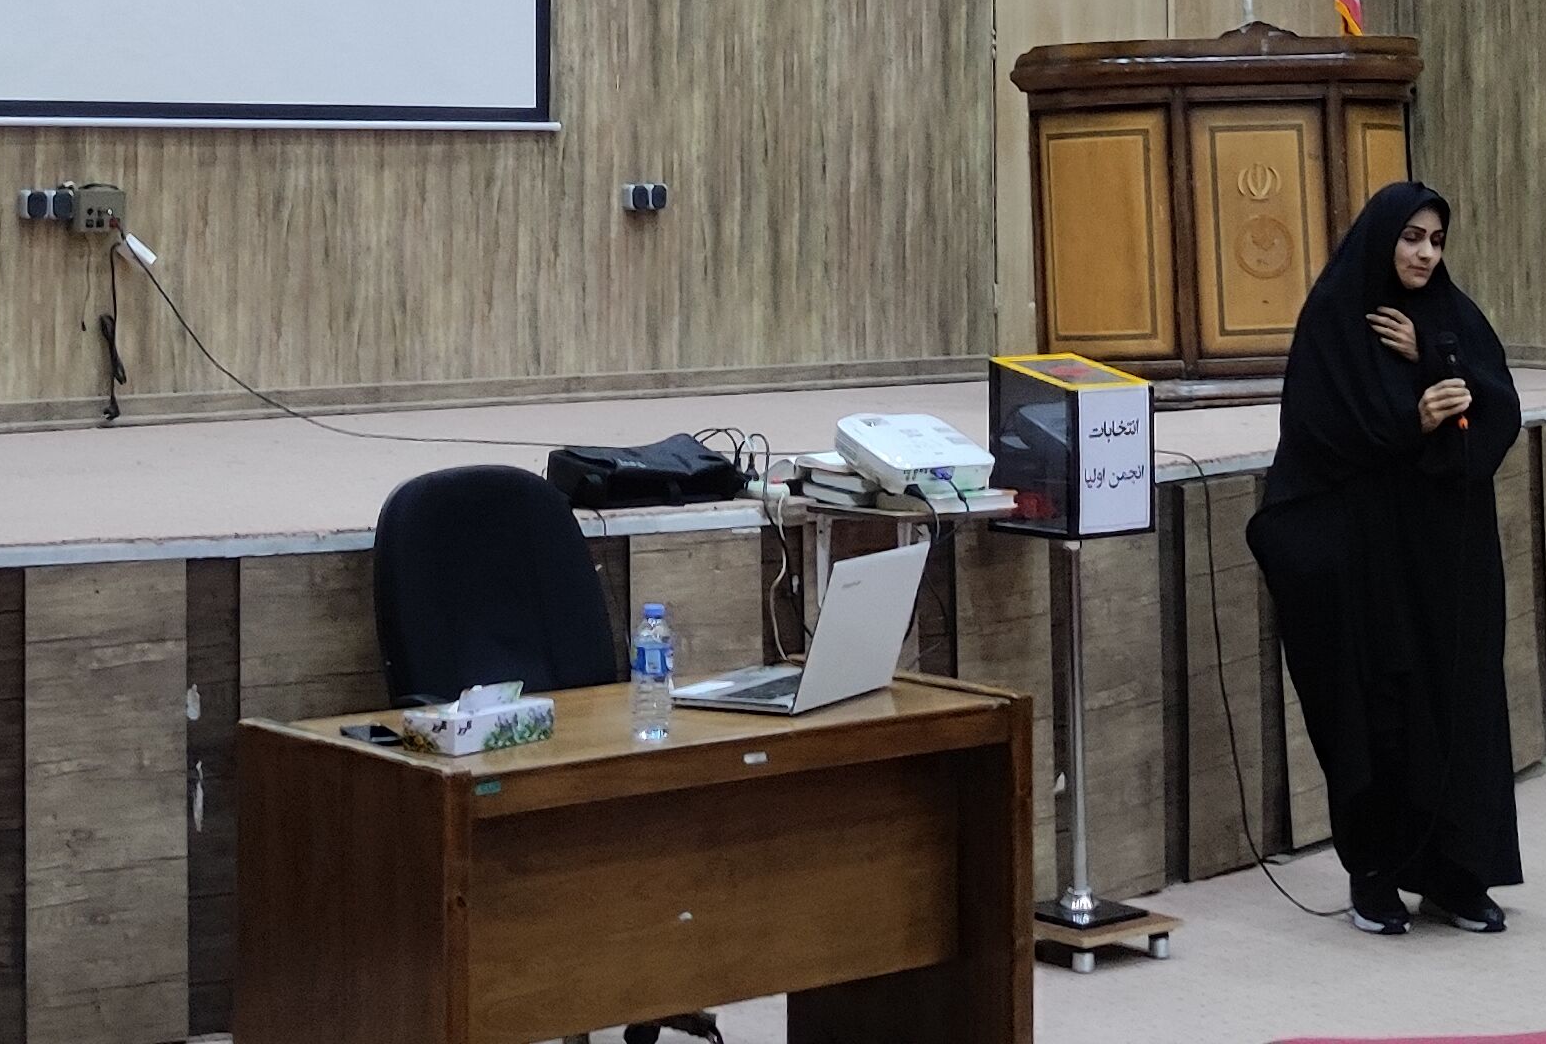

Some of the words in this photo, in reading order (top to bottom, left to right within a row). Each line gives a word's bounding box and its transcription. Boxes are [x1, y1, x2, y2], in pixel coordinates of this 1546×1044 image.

[1088, 419, 1139, 443] انتخابات
[1084, 468, 1106, 489] اولیا
[1109, 465, 1144, 489] انجمن
